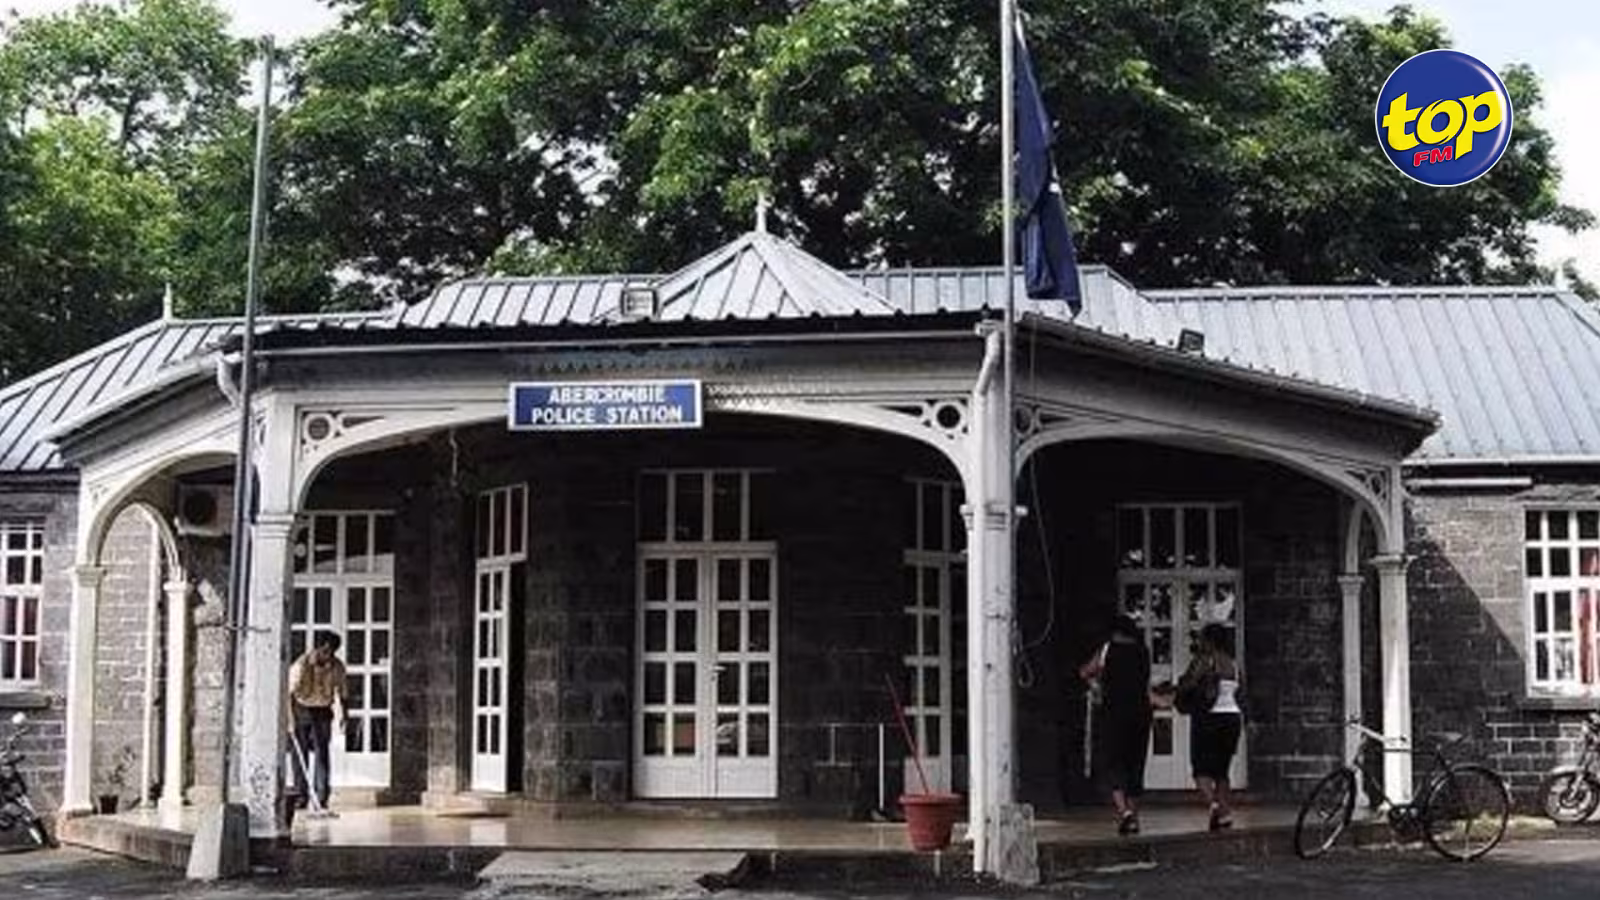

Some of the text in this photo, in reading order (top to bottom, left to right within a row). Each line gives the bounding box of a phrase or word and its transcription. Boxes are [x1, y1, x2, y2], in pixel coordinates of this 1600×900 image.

[548, 386, 665, 403] ABERCROMBIE
[531, 405, 683, 424] POLICE STATION
